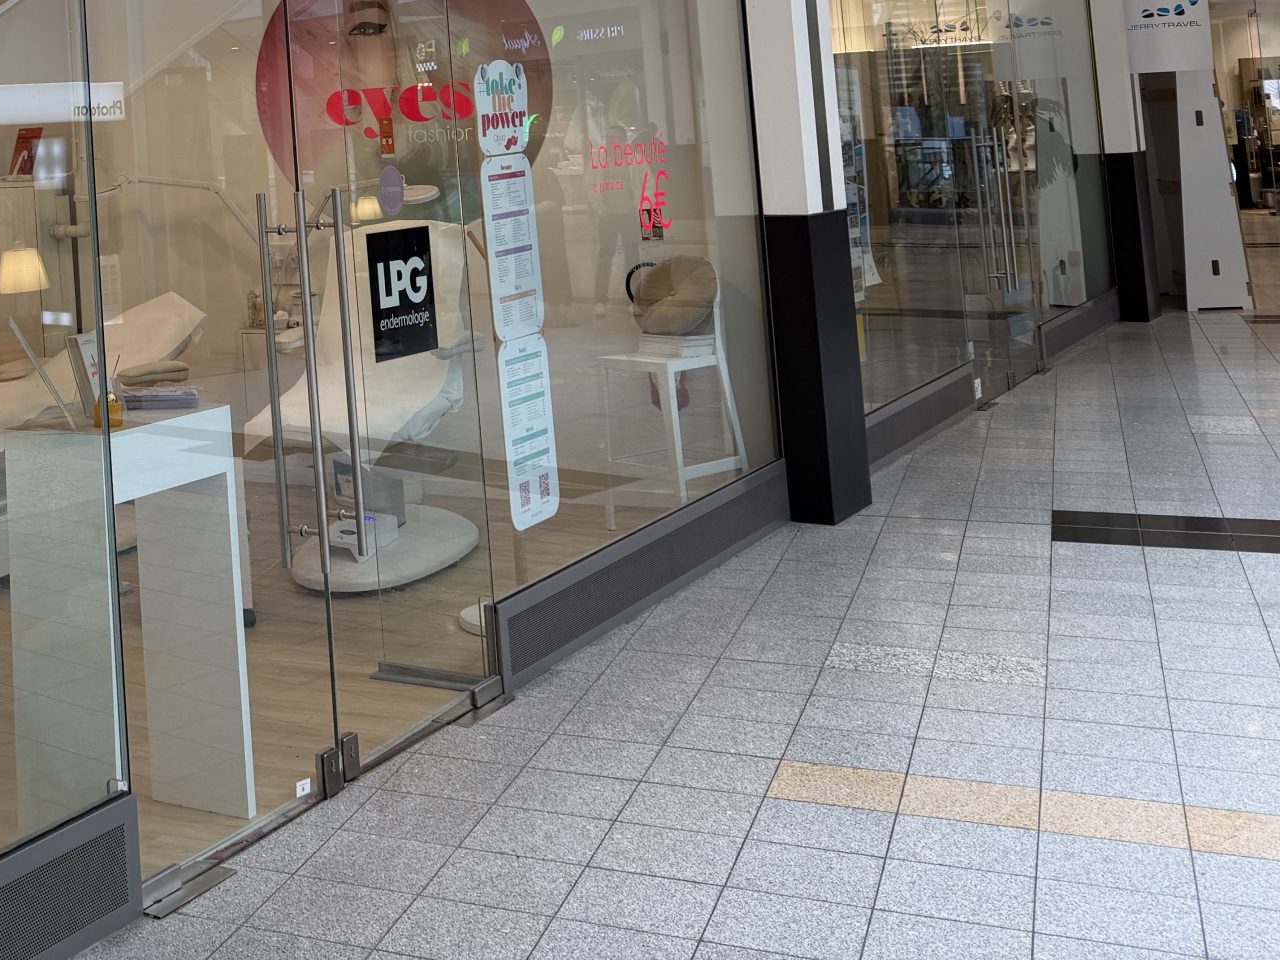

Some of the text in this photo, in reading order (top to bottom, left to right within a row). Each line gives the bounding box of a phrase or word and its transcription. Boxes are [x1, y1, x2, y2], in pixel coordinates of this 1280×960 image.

[325, 81, 475, 139] eyes
[481, 110, 526, 137] power
[589, 139, 609, 170] La
[377, 256, 428, 309] LPG
[380, 308, 430, 331] endermologie
